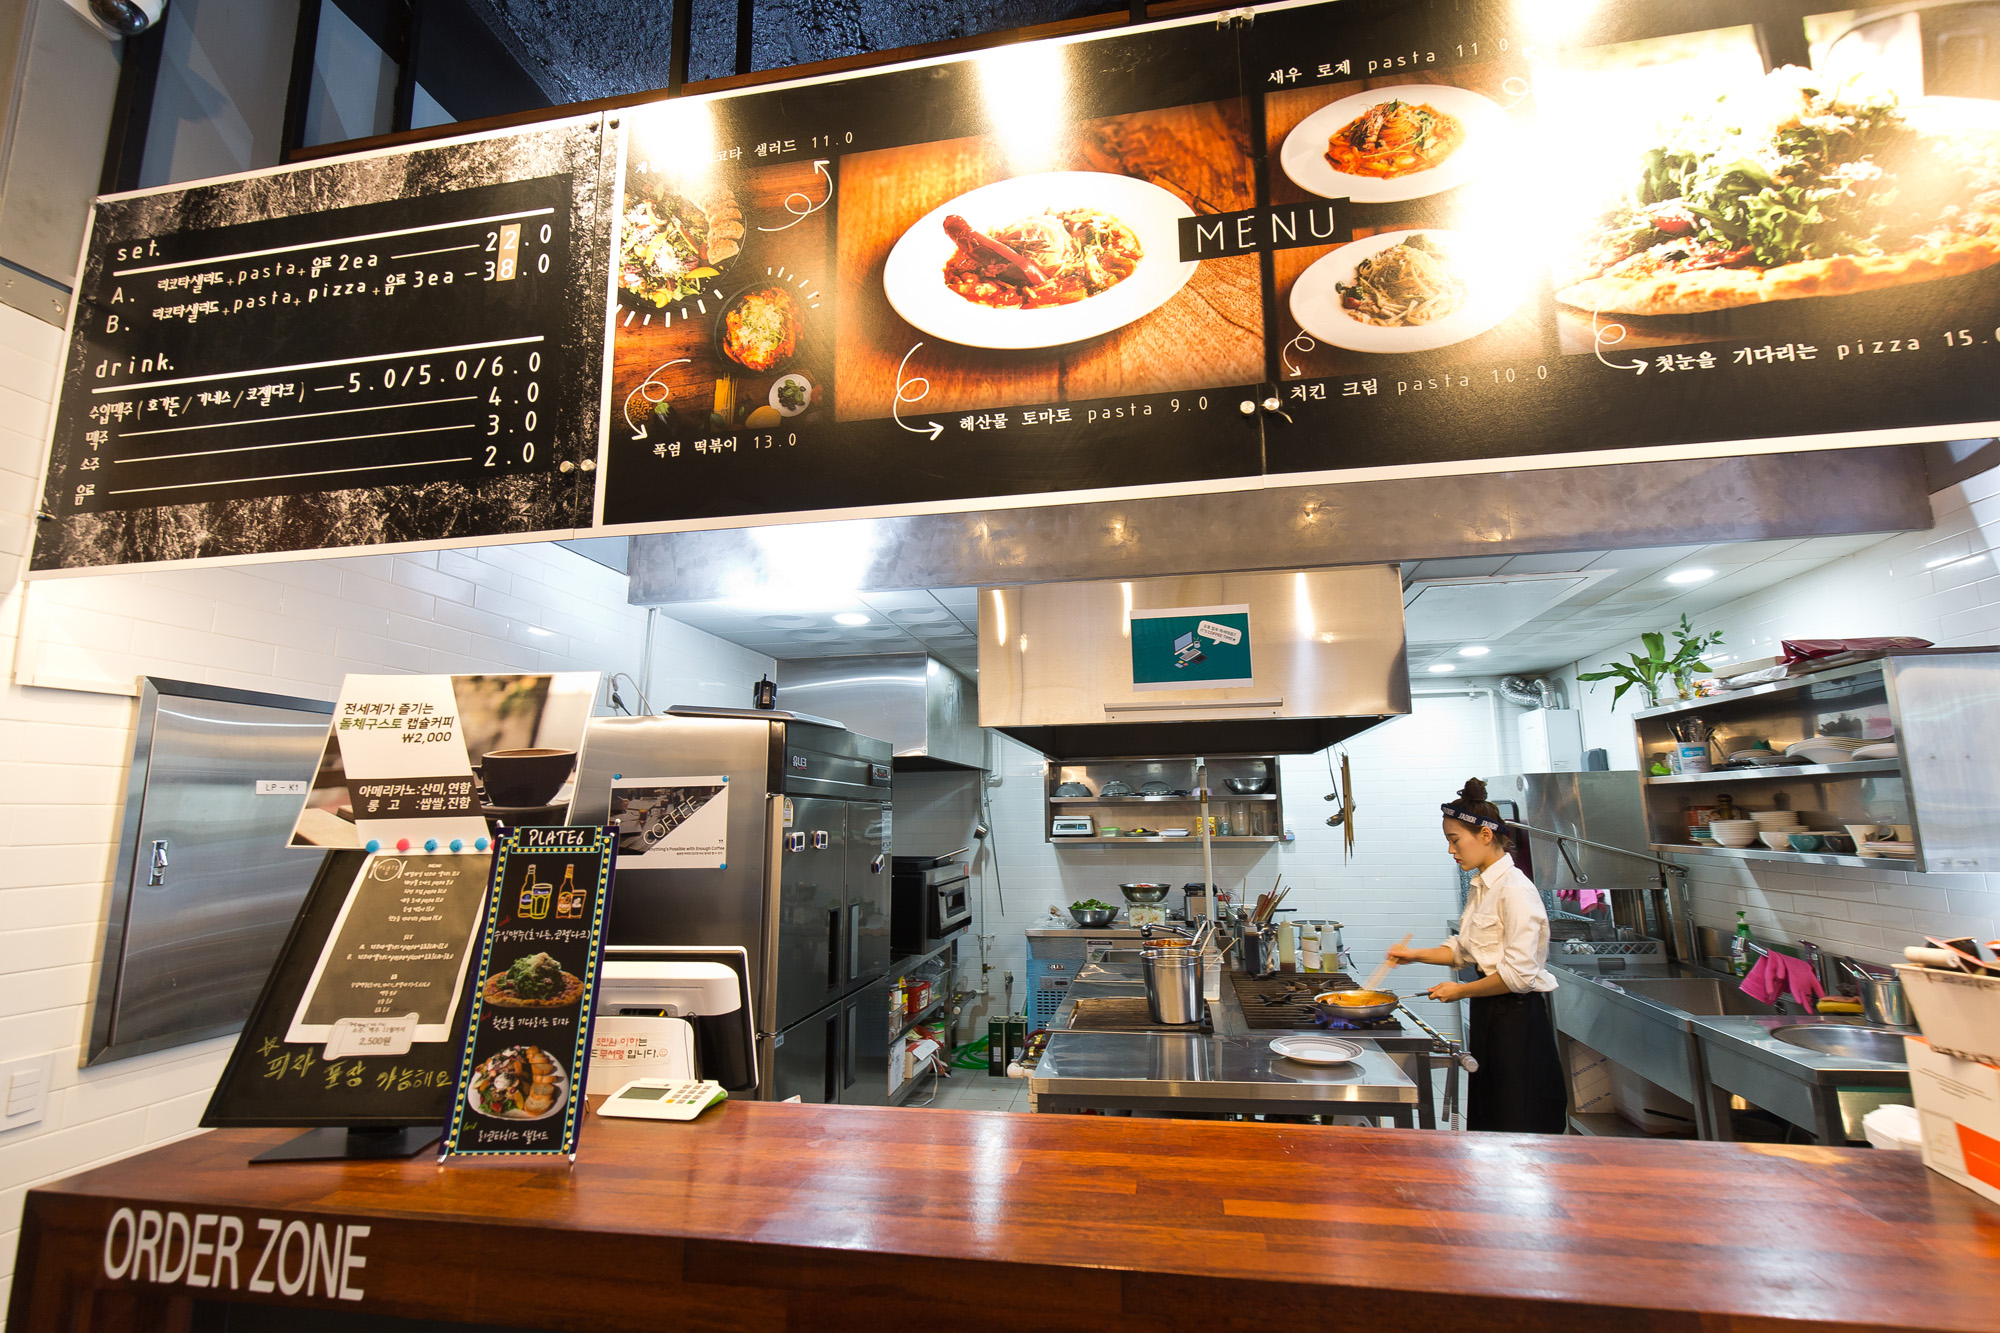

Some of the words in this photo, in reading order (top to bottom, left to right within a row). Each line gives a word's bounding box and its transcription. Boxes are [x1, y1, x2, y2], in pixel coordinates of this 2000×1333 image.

[1267, 66, 1302, 85] 새우
[1316, 59, 1351, 78] 로제
[1368, 50, 1436, 74] pasta
[1455, 38, 1509, 58] 11.0
[754, 139, 797, 158] 샐러드
[811, 131, 854, 149] 11.0
[485, 224, 551, 252] 22.0
[1196, 206, 1334, 253] MENU
[483, 254, 550, 281] 38.0
[95, 352, 174, 378] drink.
[1655, 350, 1717, 374] 첫눈을
[1733, 343, 1819, 365] 기다리는
[1837, 336, 1920, 361] pizza
[1290, 383, 1327, 401] 치킨
[1341, 378, 1378, 397] 크림
[1397, 373, 1469, 396] pasta
[85, 431, 108, 451] 맥주
[488, 382, 539, 406] 4.0
[959, 412, 1008, 432] 해산물
[1021, 407, 1073, 426] 토마토
[1088, 402, 1153, 424] pasta
[1170, 396, 1208, 413] 9.0
[80, 457, 100, 471] 소주
[487, 411, 537, 435] 3.0
[652, 441, 681, 459] 폭염
[694, 436, 737, 455] 떡볶이
[754, 433, 797, 449] 13.0
[74, 484, 95, 506] 음료
[484, 442, 535, 467] 2.0
[339, 717, 402, 730] 돌체구스토
[407, 716, 455, 730] 캡슐커피
[344, 703, 395, 715] 전세계가
[398, 703, 434, 715] 즐기는
[643, 795, 701, 845] COFFEE
[529, 829, 584, 846] PLATE6
[600, 1049, 625, 1060] 무서명
[620, 1037, 648, 1047] 이하는
[264, 1047, 316, 1080] 피자
[323, 1060, 367, 1089] 포장
[376, 1066, 452, 1091] 가능해요
[104, 1207, 244, 1290] ORDER
[249, 1218, 371, 1301] ZONE
